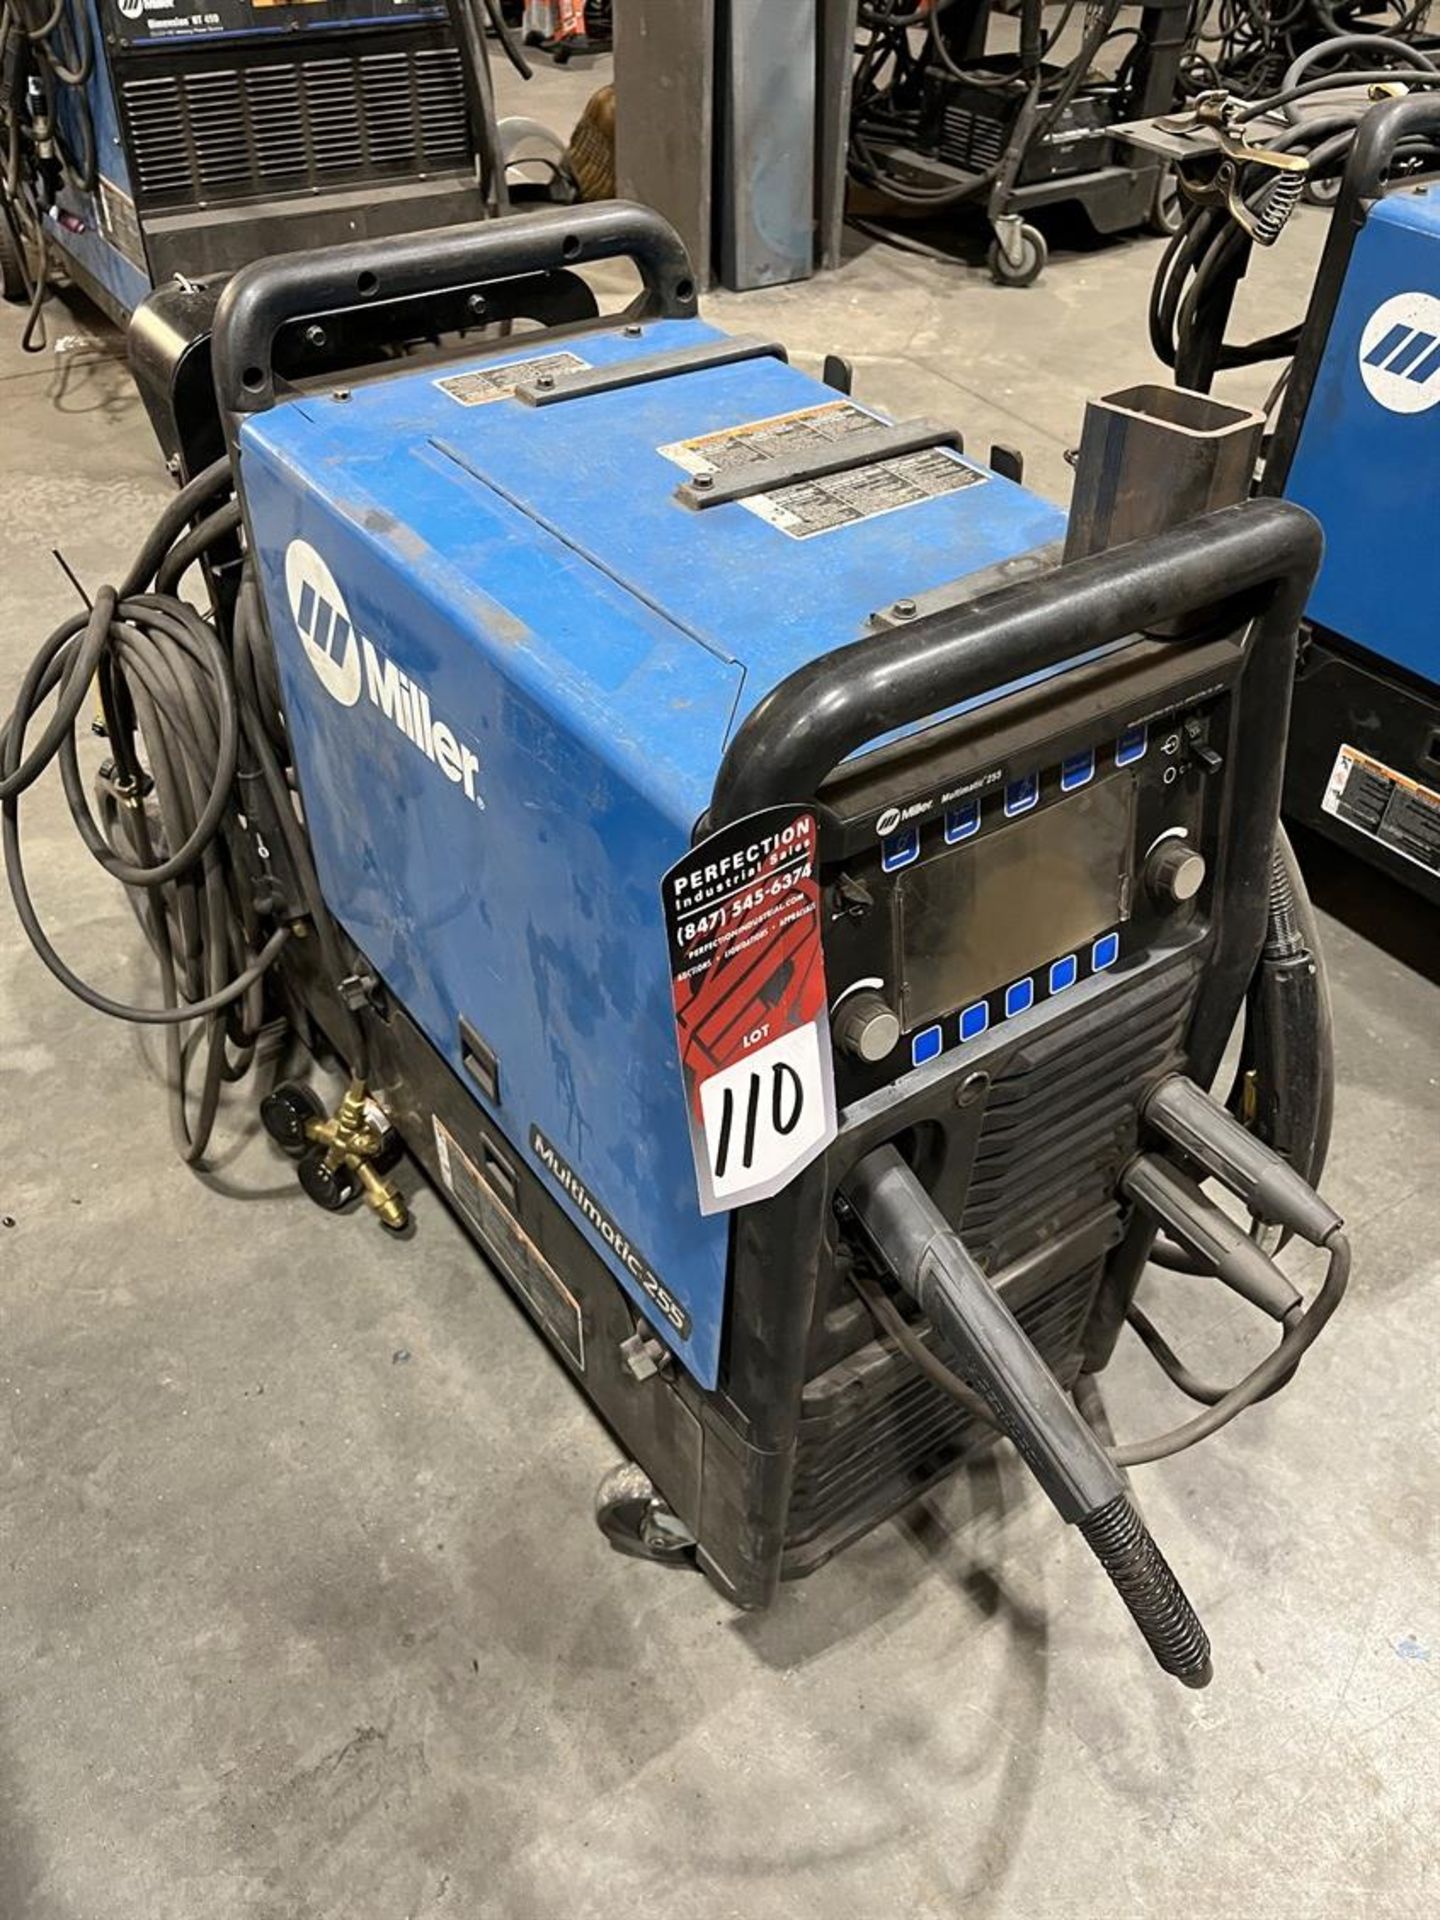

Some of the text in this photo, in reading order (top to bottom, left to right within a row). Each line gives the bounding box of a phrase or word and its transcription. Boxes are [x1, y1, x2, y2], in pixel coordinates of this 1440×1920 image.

[361, 635, 480, 802] Miller
[901, 799, 933, 821] Miller
[673, 818, 810, 896] PERFECTION
[675, 838, 811, 911] Industrial Sales
[676, 862, 812, 946] (847) 545-6374
[688, 892, 805, 960] PERFECTIONINDUSTRIAL.COM
[742, 1024, 770, 1049] LOT
[715, 1061, 804, 1178] 110
[534, 1133, 685, 1328] Multimatic 255
